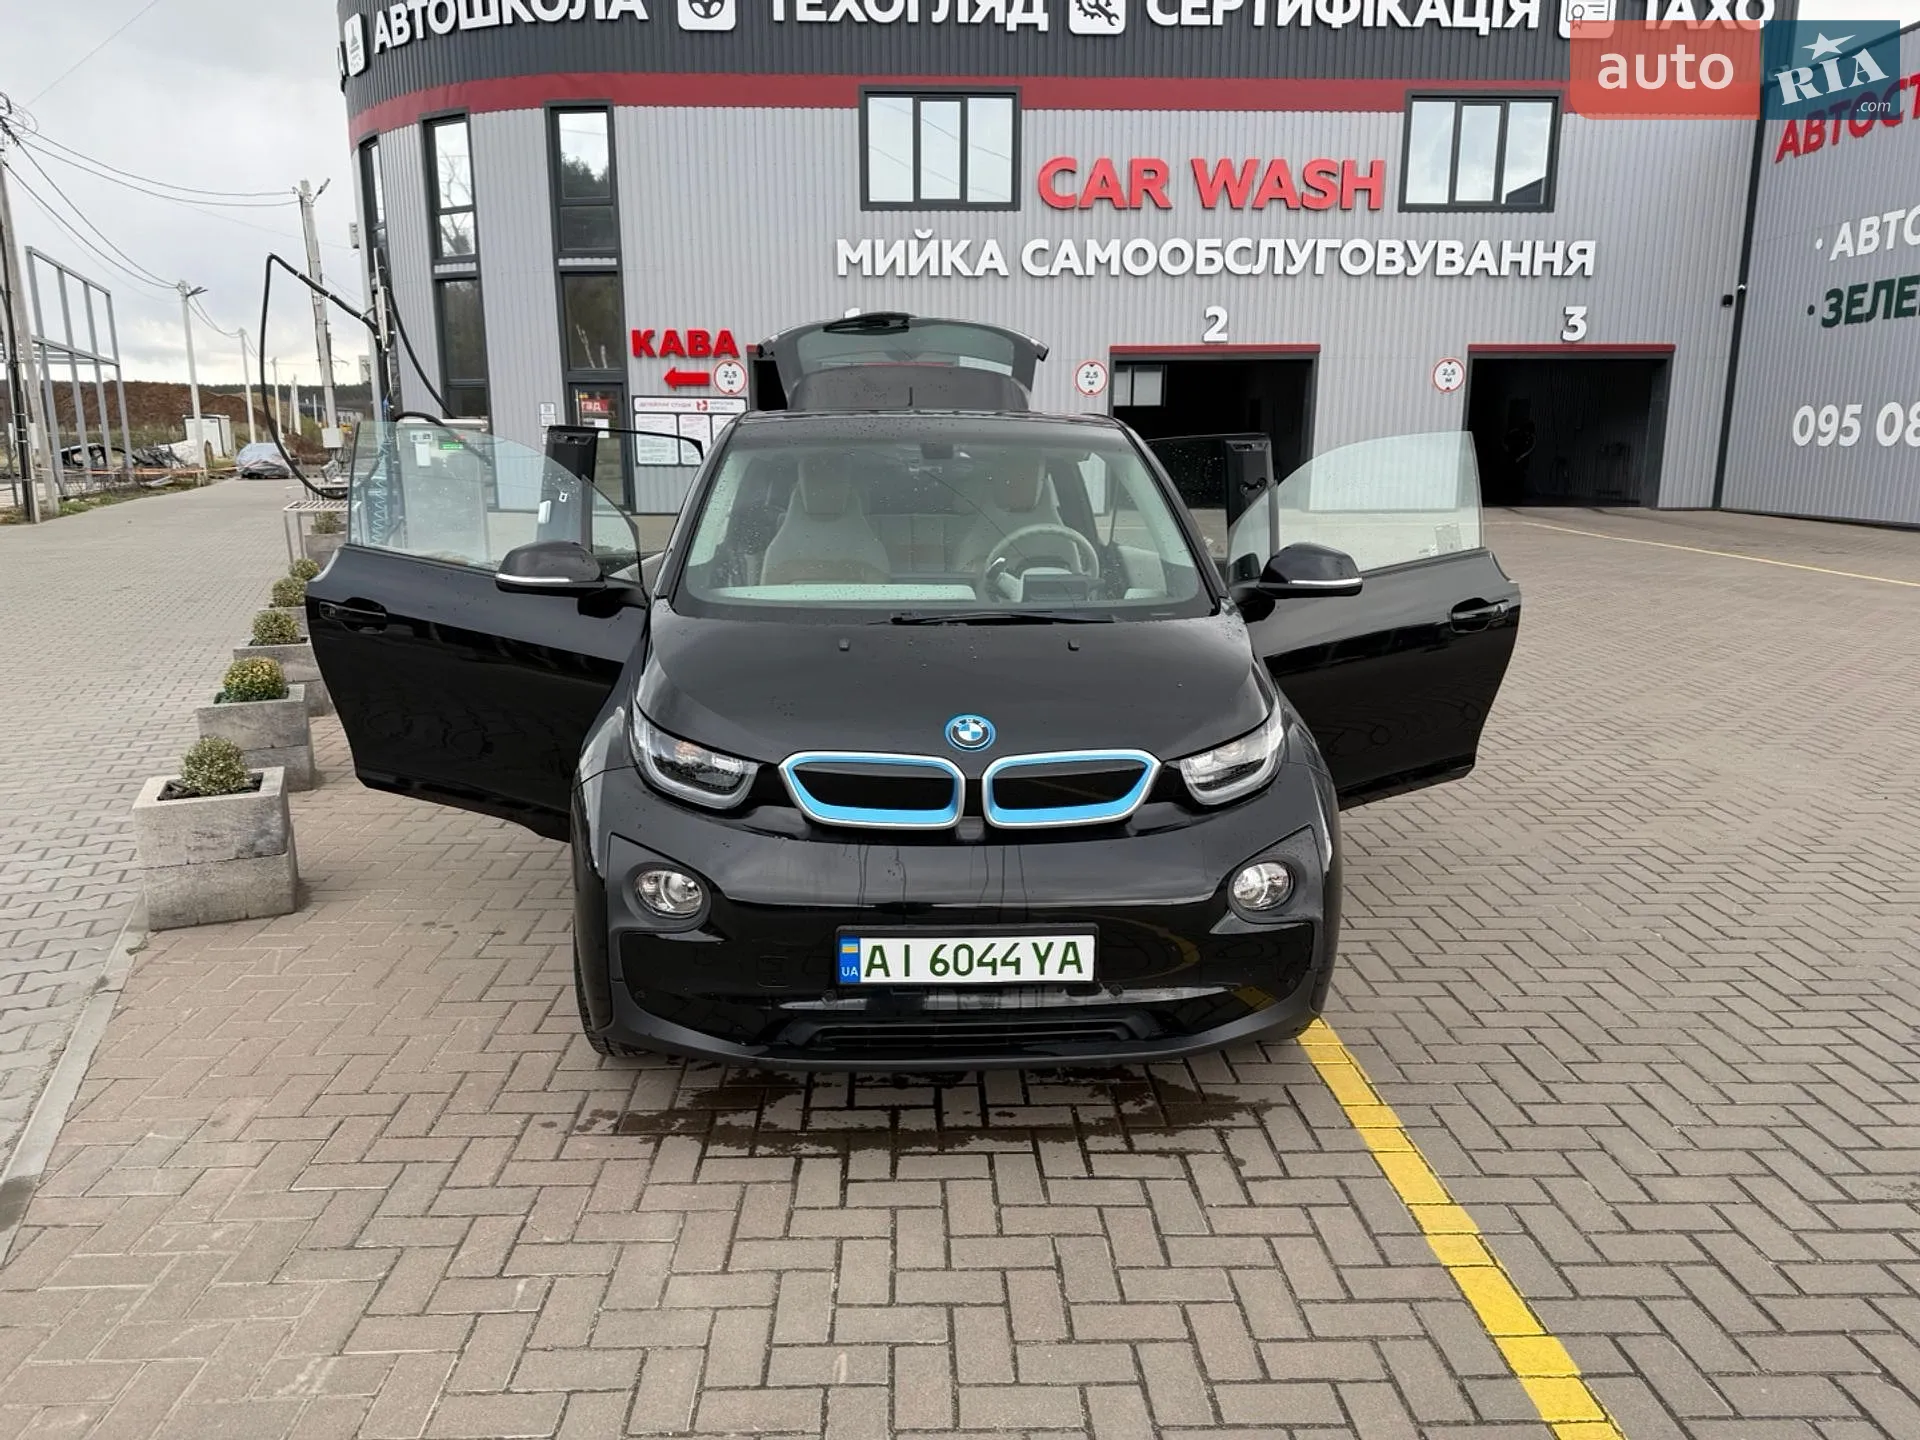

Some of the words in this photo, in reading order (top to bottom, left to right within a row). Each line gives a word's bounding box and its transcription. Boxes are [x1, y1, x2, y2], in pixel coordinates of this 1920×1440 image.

[1037, 156, 1173, 210] CAR
[1190, 157, 1384, 211] WASH
[836, 228, 1010, 277] МИЙКА
[1021, 237, 1596, 277] САМООБСЛУГОВУВАННЯ
[1202, 305, 1228, 342] 2
[1561, 306, 1587, 342] 3
[631, 329, 741, 359] КАВА
[1793, 404, 1862, 447] 095
[841, 966, 859, 977] UA
[865, 943, 911, 978] AI
[929, 942, 1021, 976] 6044
[1031, 941, 1083, 976] YA
